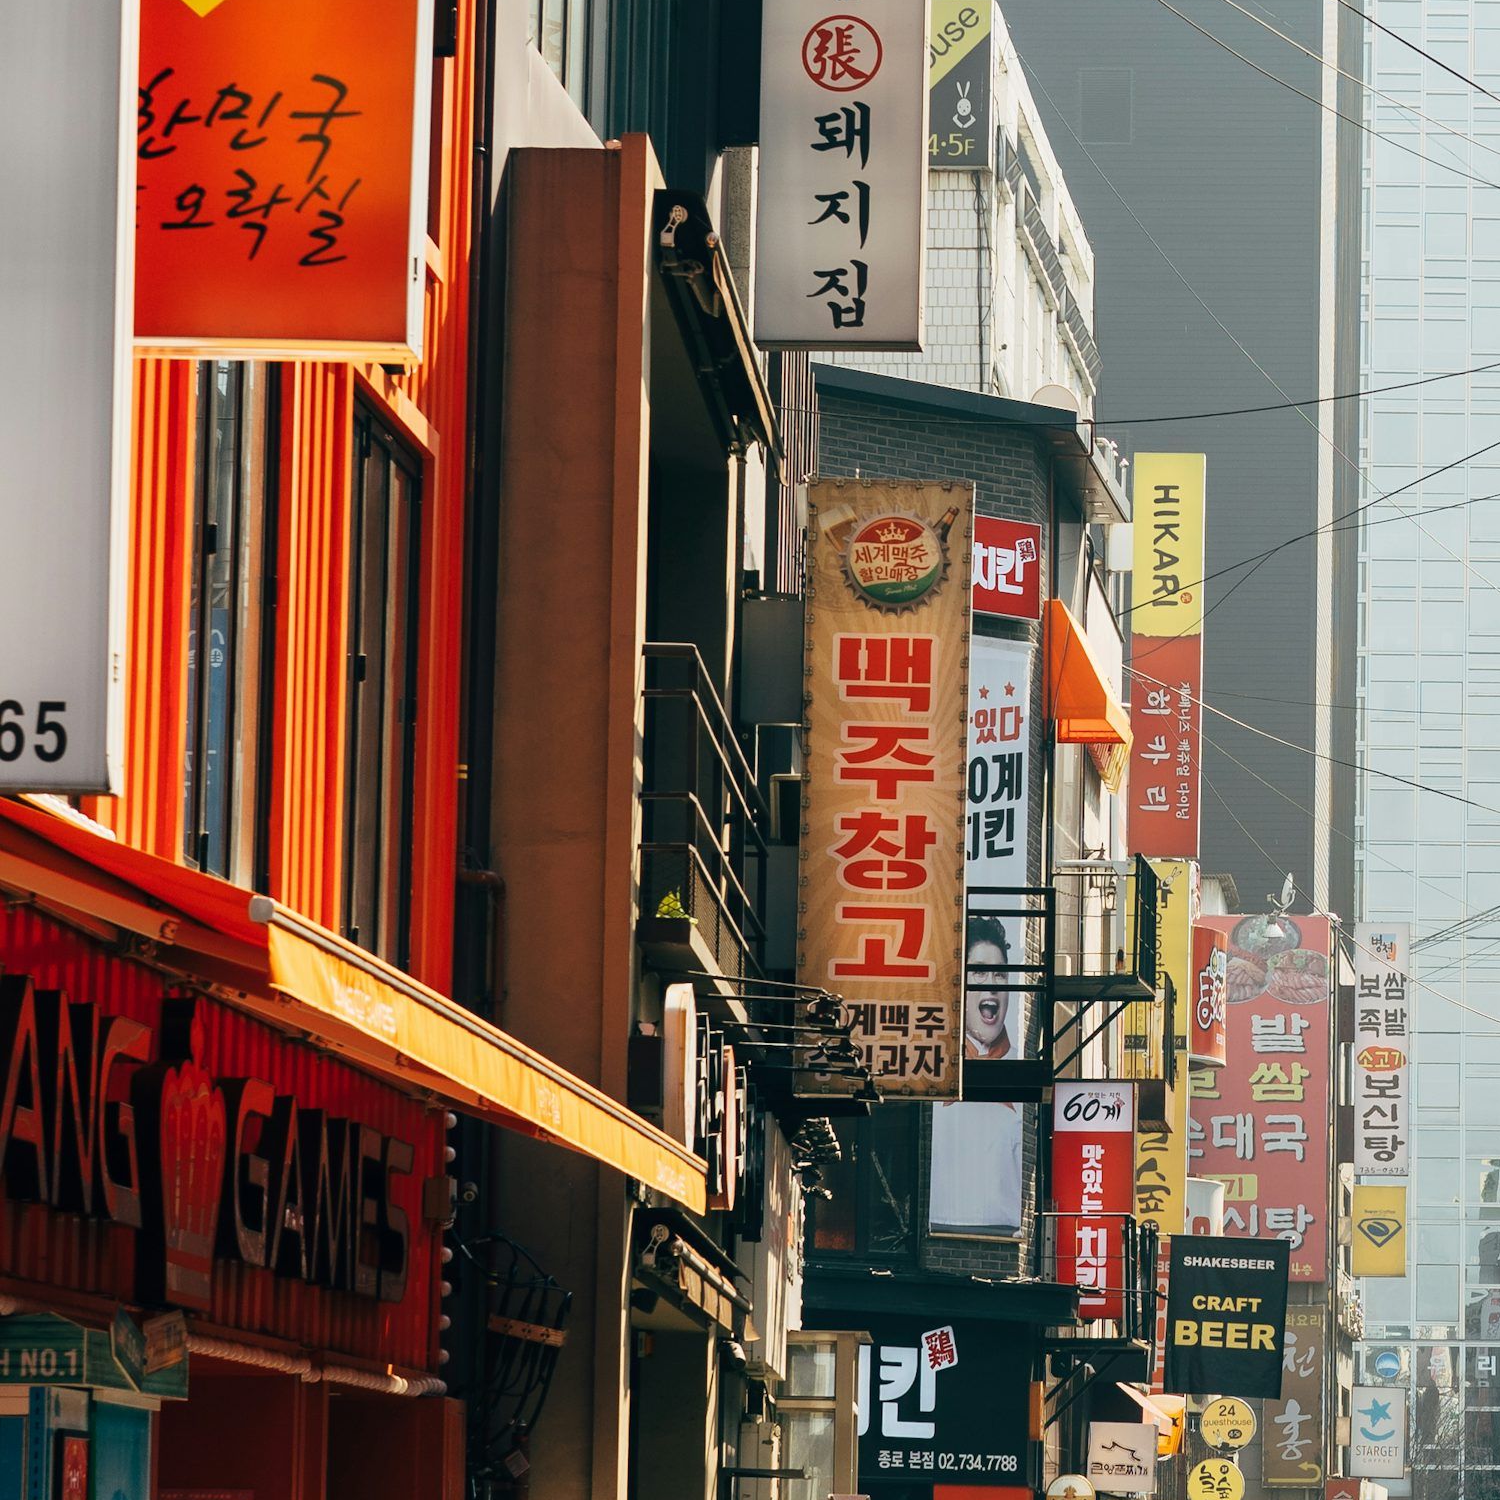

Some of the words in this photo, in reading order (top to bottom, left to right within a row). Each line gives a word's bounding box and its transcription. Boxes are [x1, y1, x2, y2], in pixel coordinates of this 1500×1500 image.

[806, 100, 872, 330] 돼지집
[852, 542, 928, 567] 세계맥주
[1151, 484, 1182, 608] HIKARI
[857, 564, 920, 584] 할인매장
[0, 699, 69, 764] 65
[1138, 687, 1171, 814] 히카리
[833, 636, 937, 978] 맥주창고
[1358, 972, 1408, 1002] 보쌈
[1358, 1007, 1408, 1038] 족발
[1358, 1049, 1405, 1070] 소고기
[1062, 1093, 1122, 1122] 60계
[1361, 1074, 1406, 1163] 보신탕
[231, 1076, 415, 1304] GAMES
[1080, 1144, 1106, 1220] 맛있는
[1075, 1225, 1108, 1307] 치킨
[1183, 1256, 1276, 1272] SHAKESBEER
[1291, 1263, 1313, 1277] 4층
[1192, 1294, 1262, 1313] CRAFT
[1174, 1320, 1276, 1352] BEER
[20, 1346, 79, 1379] NO.1
[1203, 1418, 1252, 1428] guesthouse
[1218, 1404, 1236, 1417] 24
[877, 1449, 905, 1468] 종로
[908, 1451, 935, 1470] 본점
[938, 1451, 1018, 1473] 02.734.7788
[1355, 1445, 1400, 1458] STARGET
